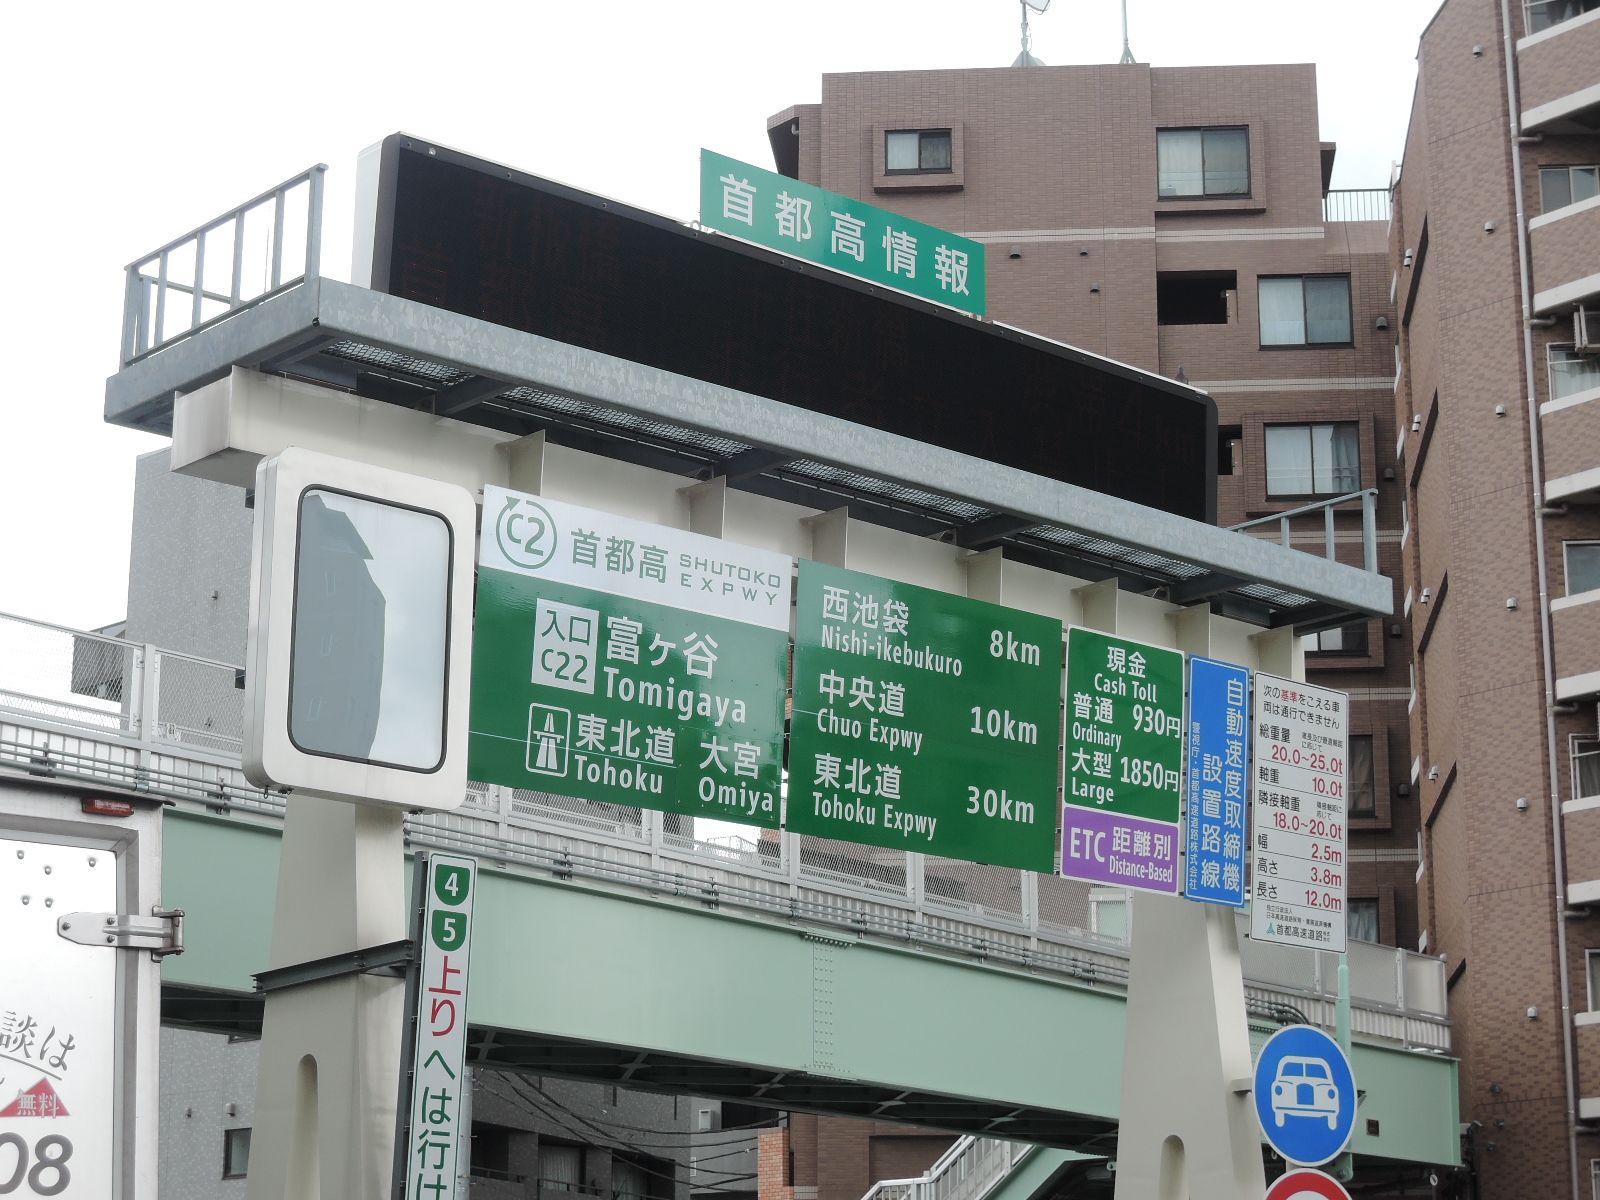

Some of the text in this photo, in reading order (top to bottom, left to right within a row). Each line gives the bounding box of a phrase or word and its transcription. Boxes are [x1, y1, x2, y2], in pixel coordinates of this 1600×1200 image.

[720, 173, 970, 296] 首都高情報
[506, 513, 545, 556] C2
[570, 528, 669, 583] 首都高
[679, 554, 781, 589] SHUTOKO
[681, 574, 777, 605] EXPWY
[541, 610, 591, 646] 入口
[822, 585, 1040, 666] 西池袋 8km
[541, 648, 588, 684] C22
[821, 624, 962, 677] Nishi-ikebukuro
[1106, 646, 1147, 678] 現金
[603, 666, 746, 727] Tomigaya
[1094, 673, 1157, 703] Cash Toll
[1263, 684, 1340, 713] 次の基準をこえる車
[819, 669, 1037, 745] 中央道 10km
[1073, 691, 1181, 738] 普通 930円
[1263, 700, 1340, 730] 両は通行できません
[575, 713, 761, 780] 東北道 大宮
[817, 708, 923, 756] Chuo Expwy
[1072, 721, 1122, 752] Ordinary
[1259, 722, 1290, 744] 総重量
[574, 754, 773, 815] Tohoku Omiya
[1071, 747, 1179, 792] 大型 1850円
[1222, 677, 1244, 893] 自動速度取締機
[1259, 766, 1343, 797] 軸重 10.0t
[813, 752, 1034, 824] 東北道 30km
[1071, 777, 1115, 805] Large
[1258, 789, 1300, 812] 隣接軸重
[813, 791, 937, 841] Tohoku Expwy
[1201, 753, 1222, 889] 設置路線
[1070, 826, 1171, 863] ETC 距離別
[1258, 833, 1342, 863] 幅 2.5m
[444, 872, 459, 897] 4
[1109, 855, 1173, 883] Distance-Based
[1257, 857, 1342, 887] 高さ 3.8m
[1256, 881, 1342, 911] 長さ 12.0m
[442, 917, 456, 943] 5
[1276, 924, 1323, 942] 首都高速道路
[17, 1088, 60, 1119] 無料
